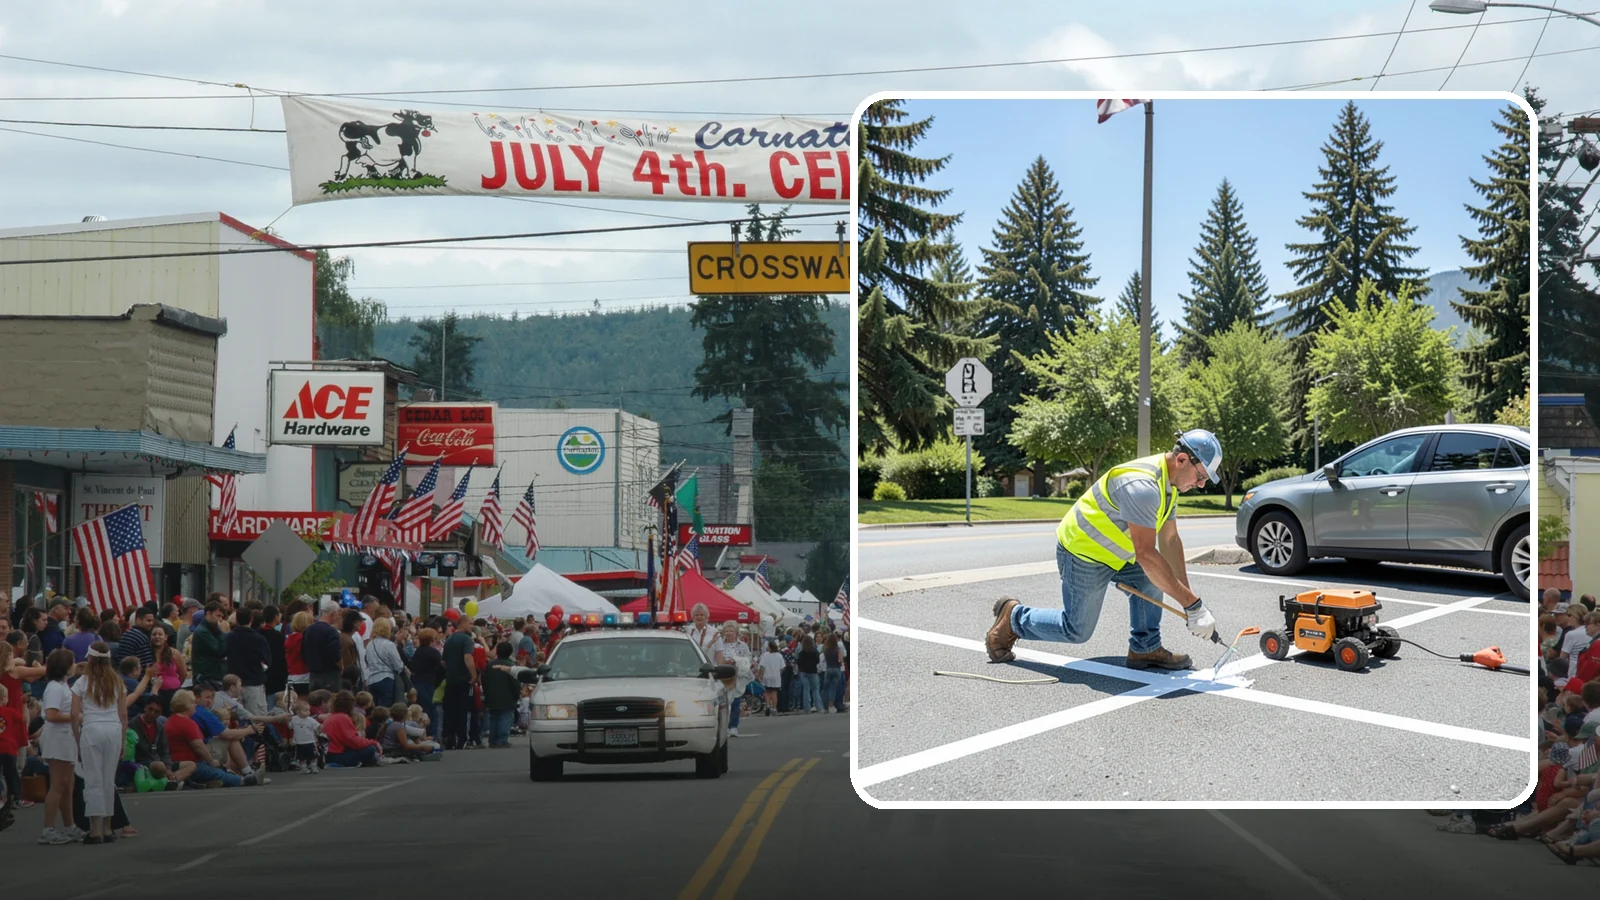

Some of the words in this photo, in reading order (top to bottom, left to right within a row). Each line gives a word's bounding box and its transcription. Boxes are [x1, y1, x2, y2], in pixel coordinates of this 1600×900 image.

[695, 121, 850, 150] Carnat
[481, 140, 605, 192] JULY
[632, 149, 747, 198] 4th.
[696, 253, 850, 280] CROSSWA
[282, 379, 374, 421] ACE
[405, 409, 452, 422] CEDAR
[460, 409, 486, 422] LOG
[283, 420, 371, 437] Hardware
[416, 428, 477, 447] Coca-Cola
[353, 466, 386, 480] Simpl
[83, 484, 94, 494] St.
[96, 485, 124, 495] Vincent
[126, 485, 136, 494] de
[137, 485, 155, 495] Paul
[212, 515, 331, 537] HARDARE
[688, 526, 742, 535] CRNATION
[699, 535, 730, 544] GLASS
